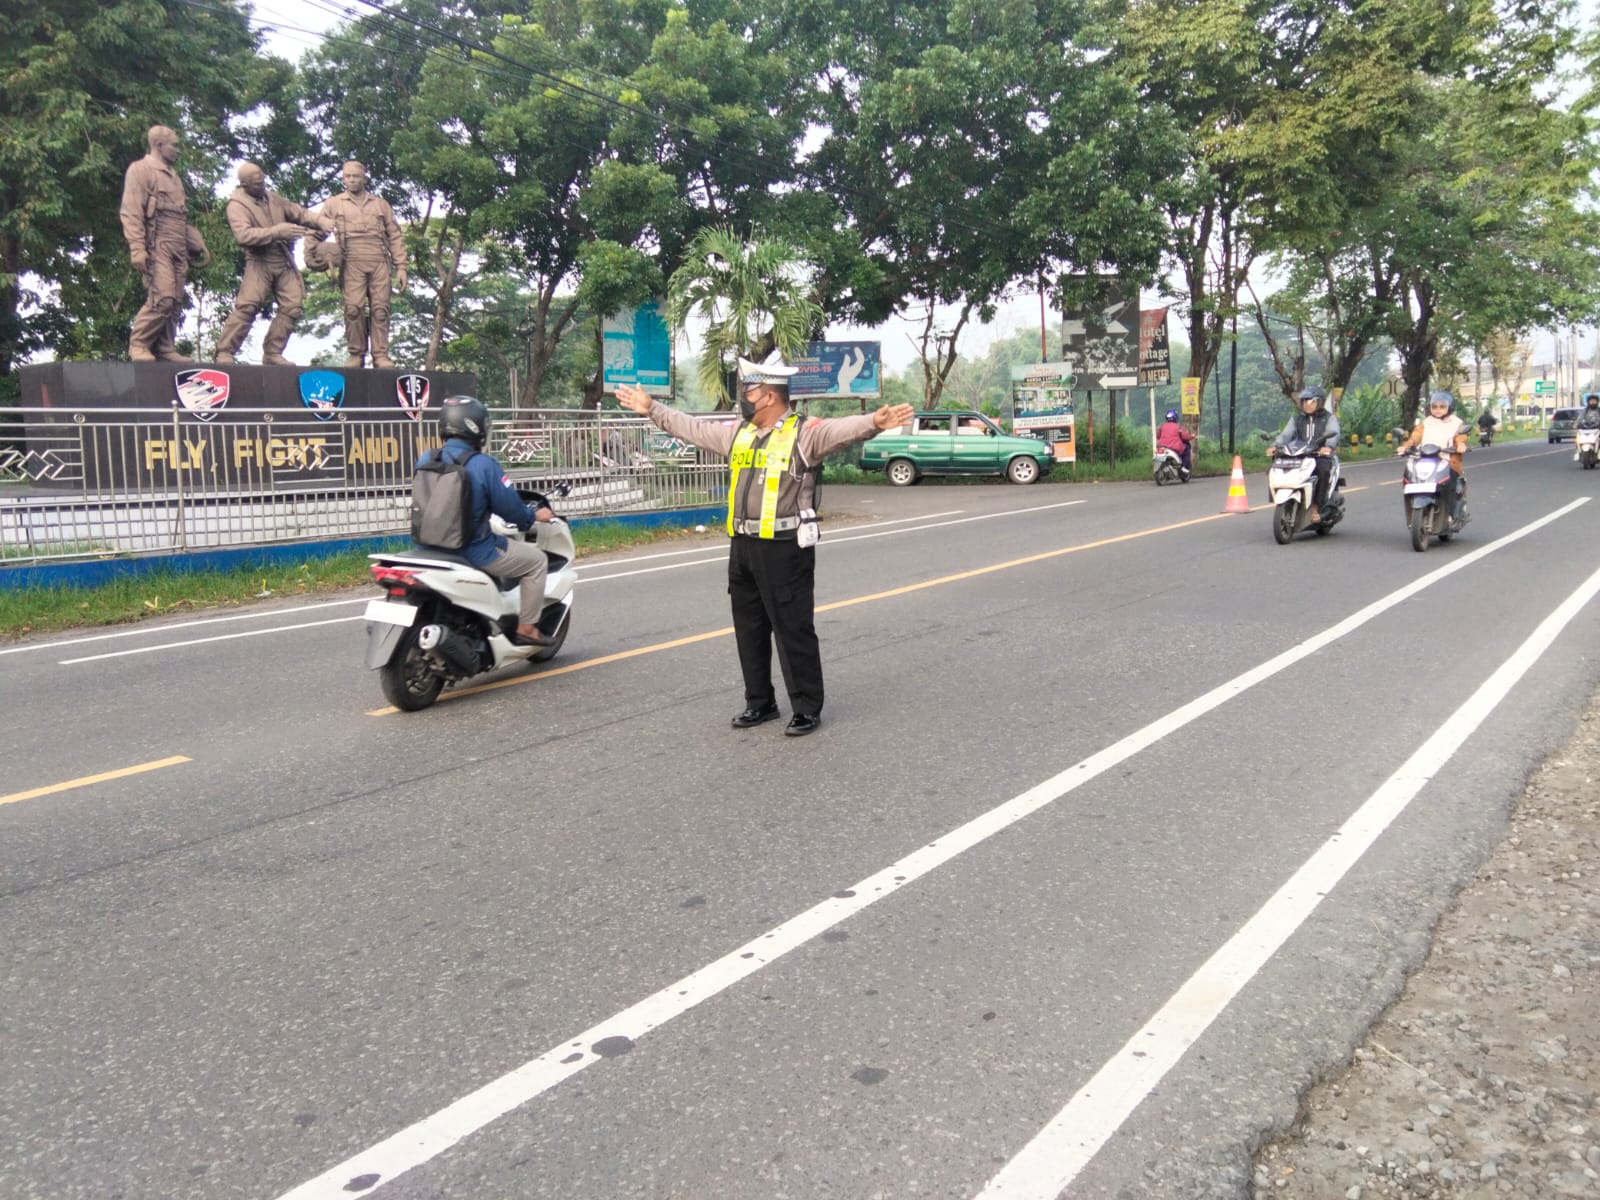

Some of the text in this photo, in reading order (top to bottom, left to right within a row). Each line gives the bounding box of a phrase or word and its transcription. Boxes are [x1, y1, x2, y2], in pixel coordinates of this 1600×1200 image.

[1139, 349, 1168, 360] ottage
[797, 364, 832, 374] OVID-19
[144, 439, 217, 472] FLY,
[233, 437, 326, 468] FIGHT
[348, 436, 399, 465] AND
